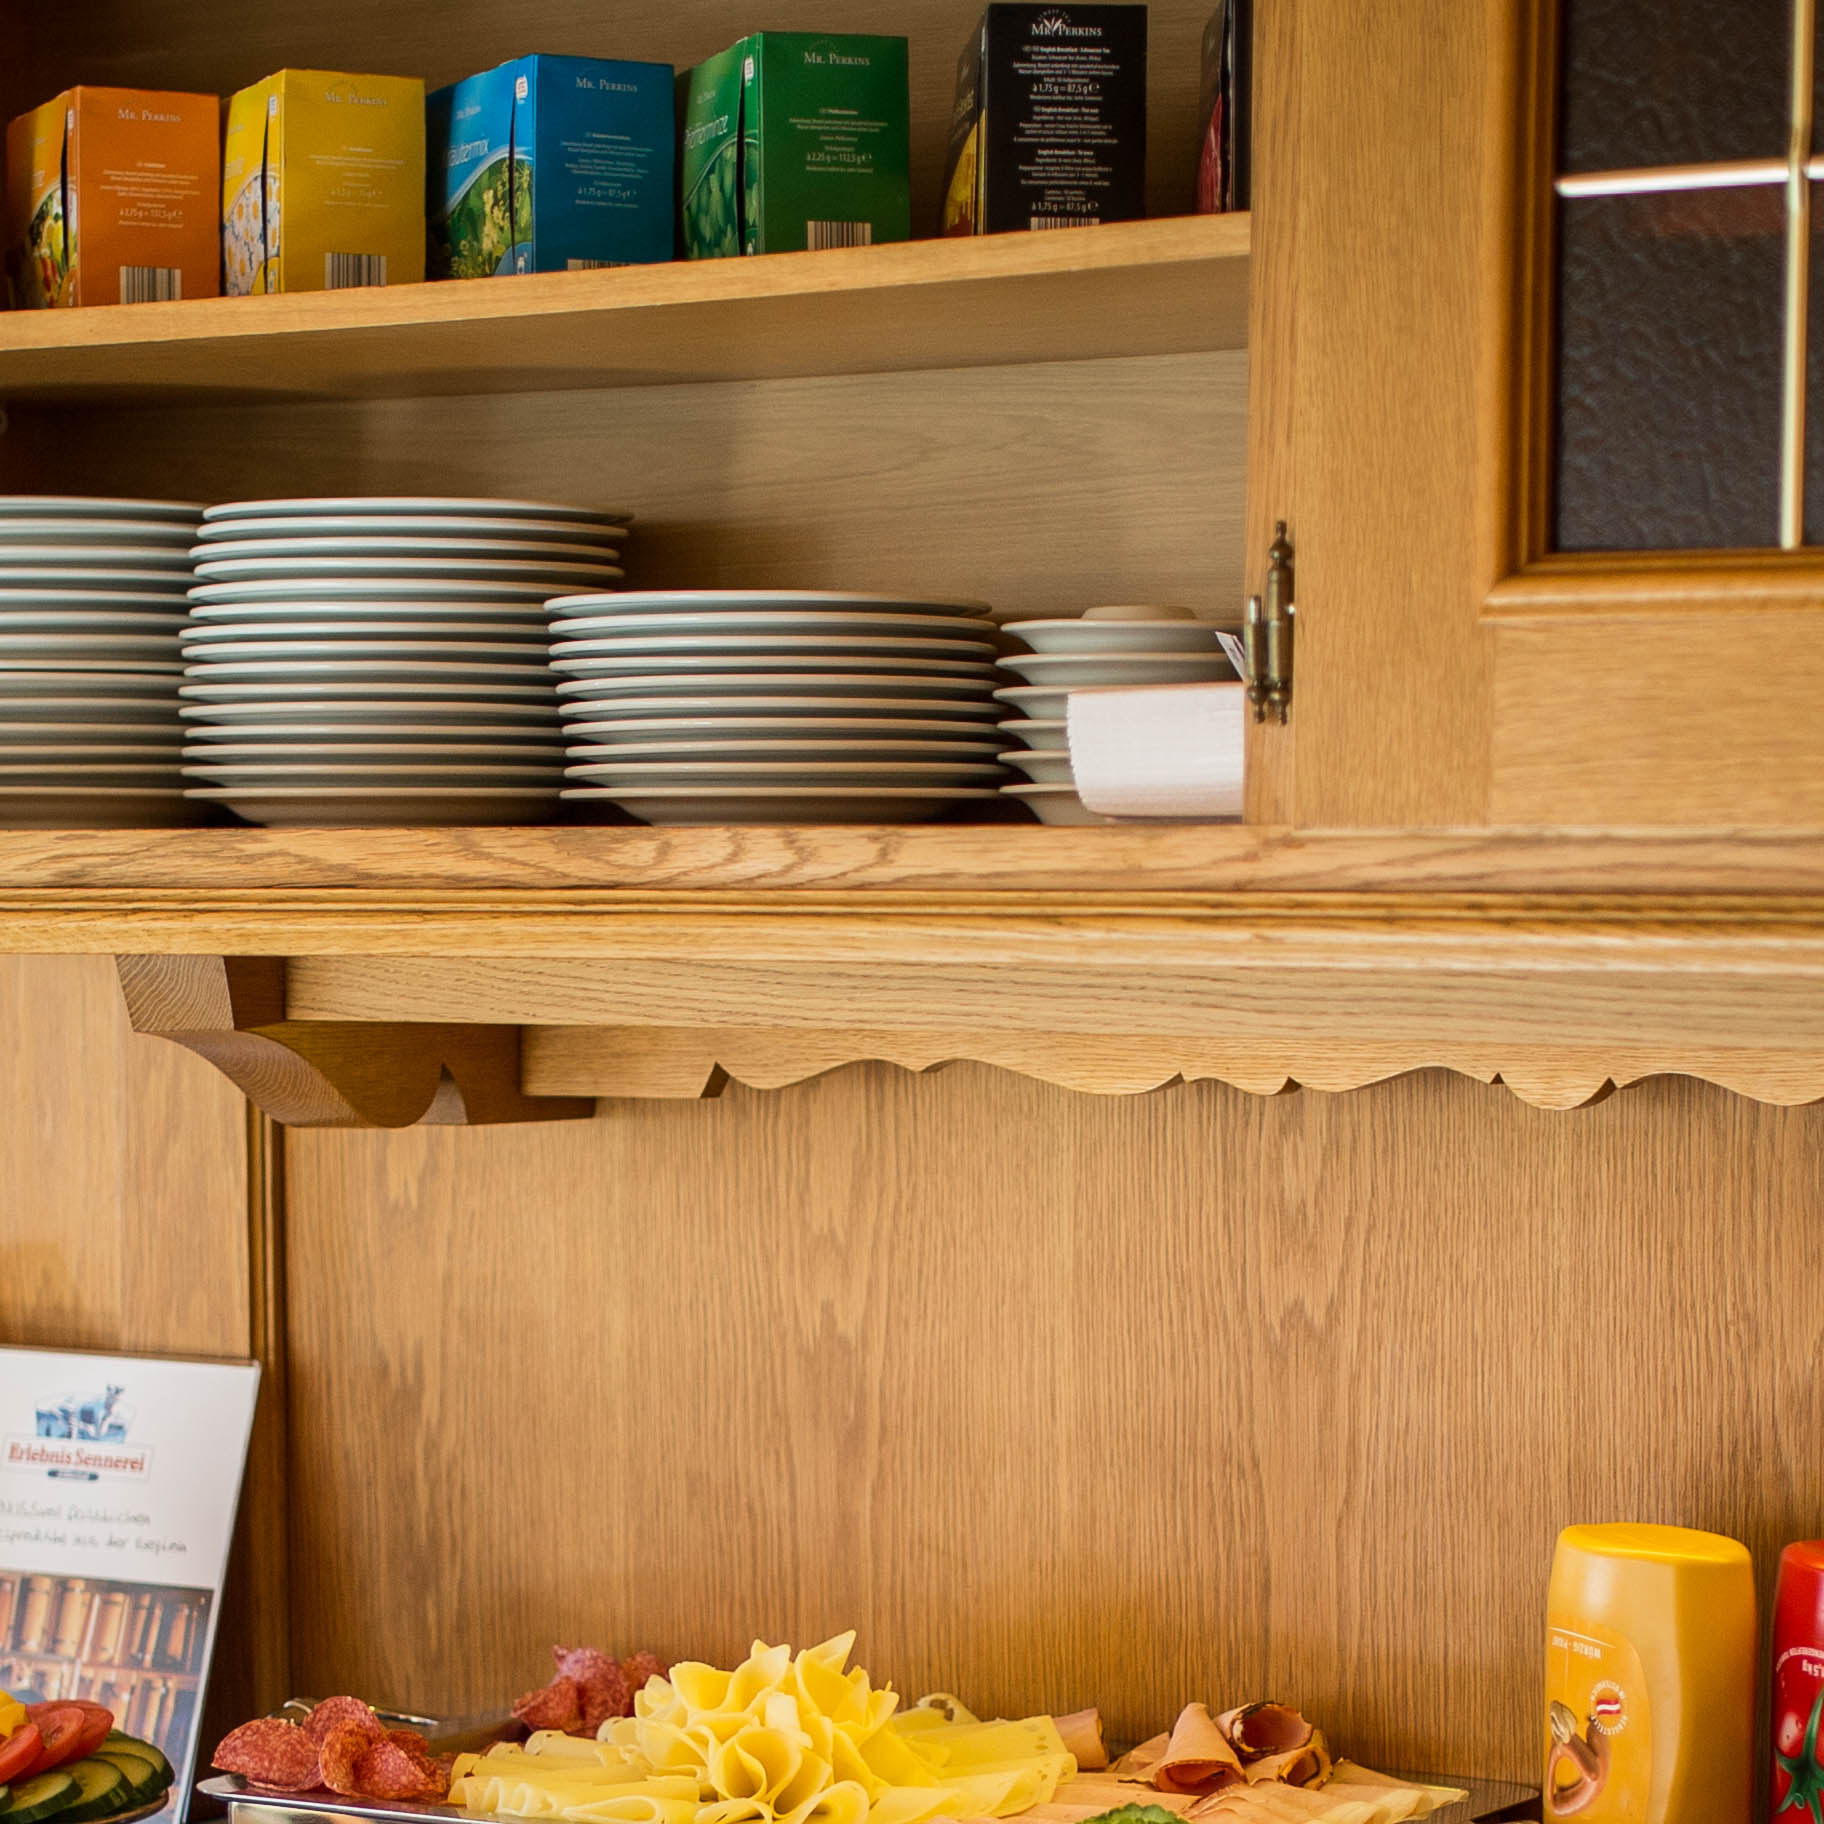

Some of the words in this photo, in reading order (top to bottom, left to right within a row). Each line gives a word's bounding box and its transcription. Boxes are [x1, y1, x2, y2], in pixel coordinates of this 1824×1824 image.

[1059, 23, 1102, 36] PERKINS
[829, 51, 870, 66] PERKINS
[599, 78, 638, 92] PERKINS
[8, 1441, 72, 1465] Erlebnis
[74, 1447, 146, 1472] Sennerei
